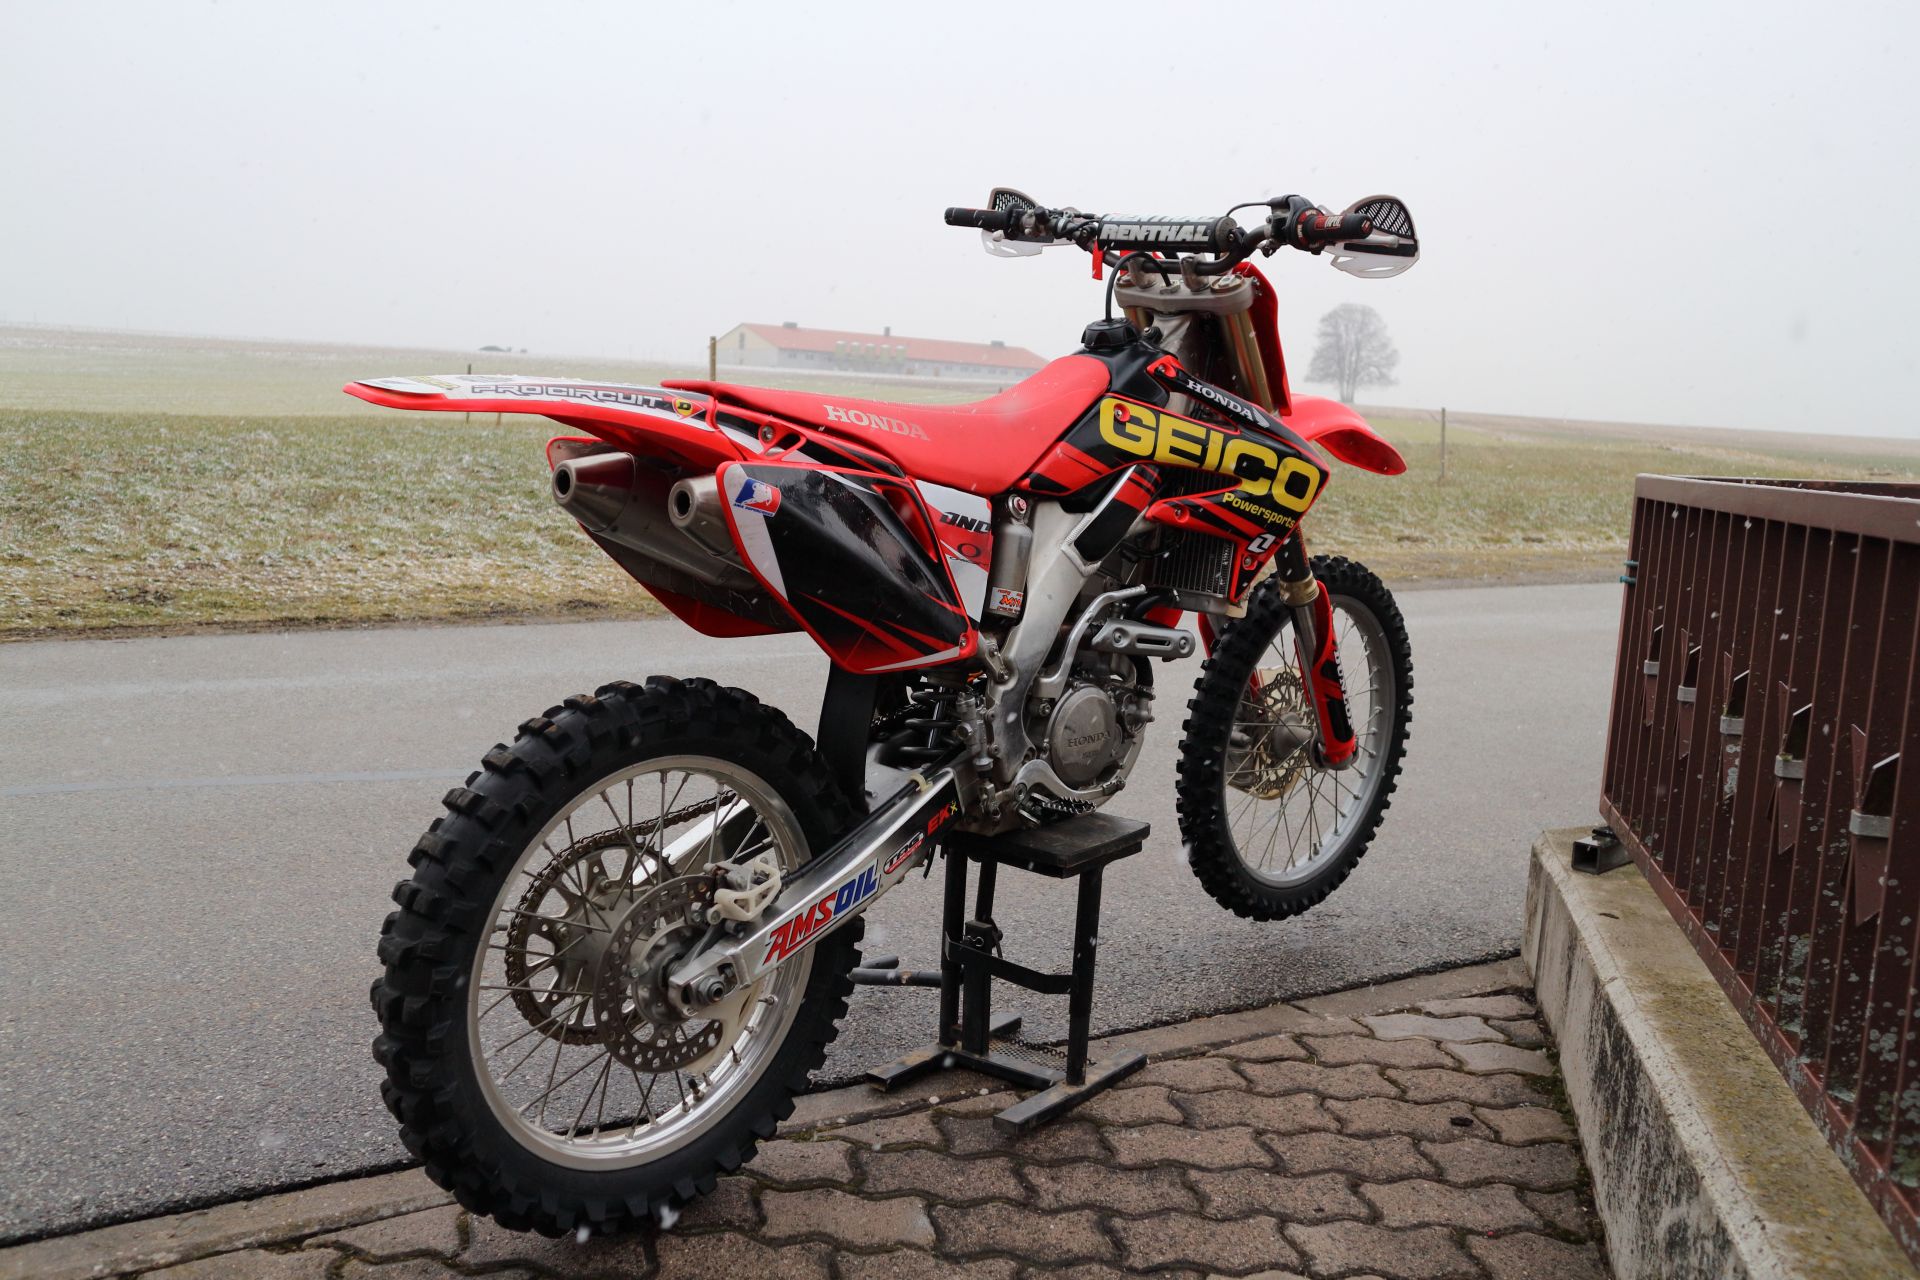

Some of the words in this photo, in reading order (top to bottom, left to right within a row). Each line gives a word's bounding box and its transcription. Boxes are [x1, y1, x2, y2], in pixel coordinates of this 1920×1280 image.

[1100, 223, 1209, 242] RENTHAL
[472, 384, 544, 397] PRO
[545, 386, 663, 410] CIRCUIT
[1186, 379, 1254, 422] HONDA
[823, 404, 930, 442] HONDA
[1099, 397, 1321, 513] GEICO
[1222, 492, 1296, 529] Powersports
[1333, 648, 1355, 729] DUNLOP
[1066, 731, 1112, 748] HONDA
[762, 859, 880, 966] AMSOIL
